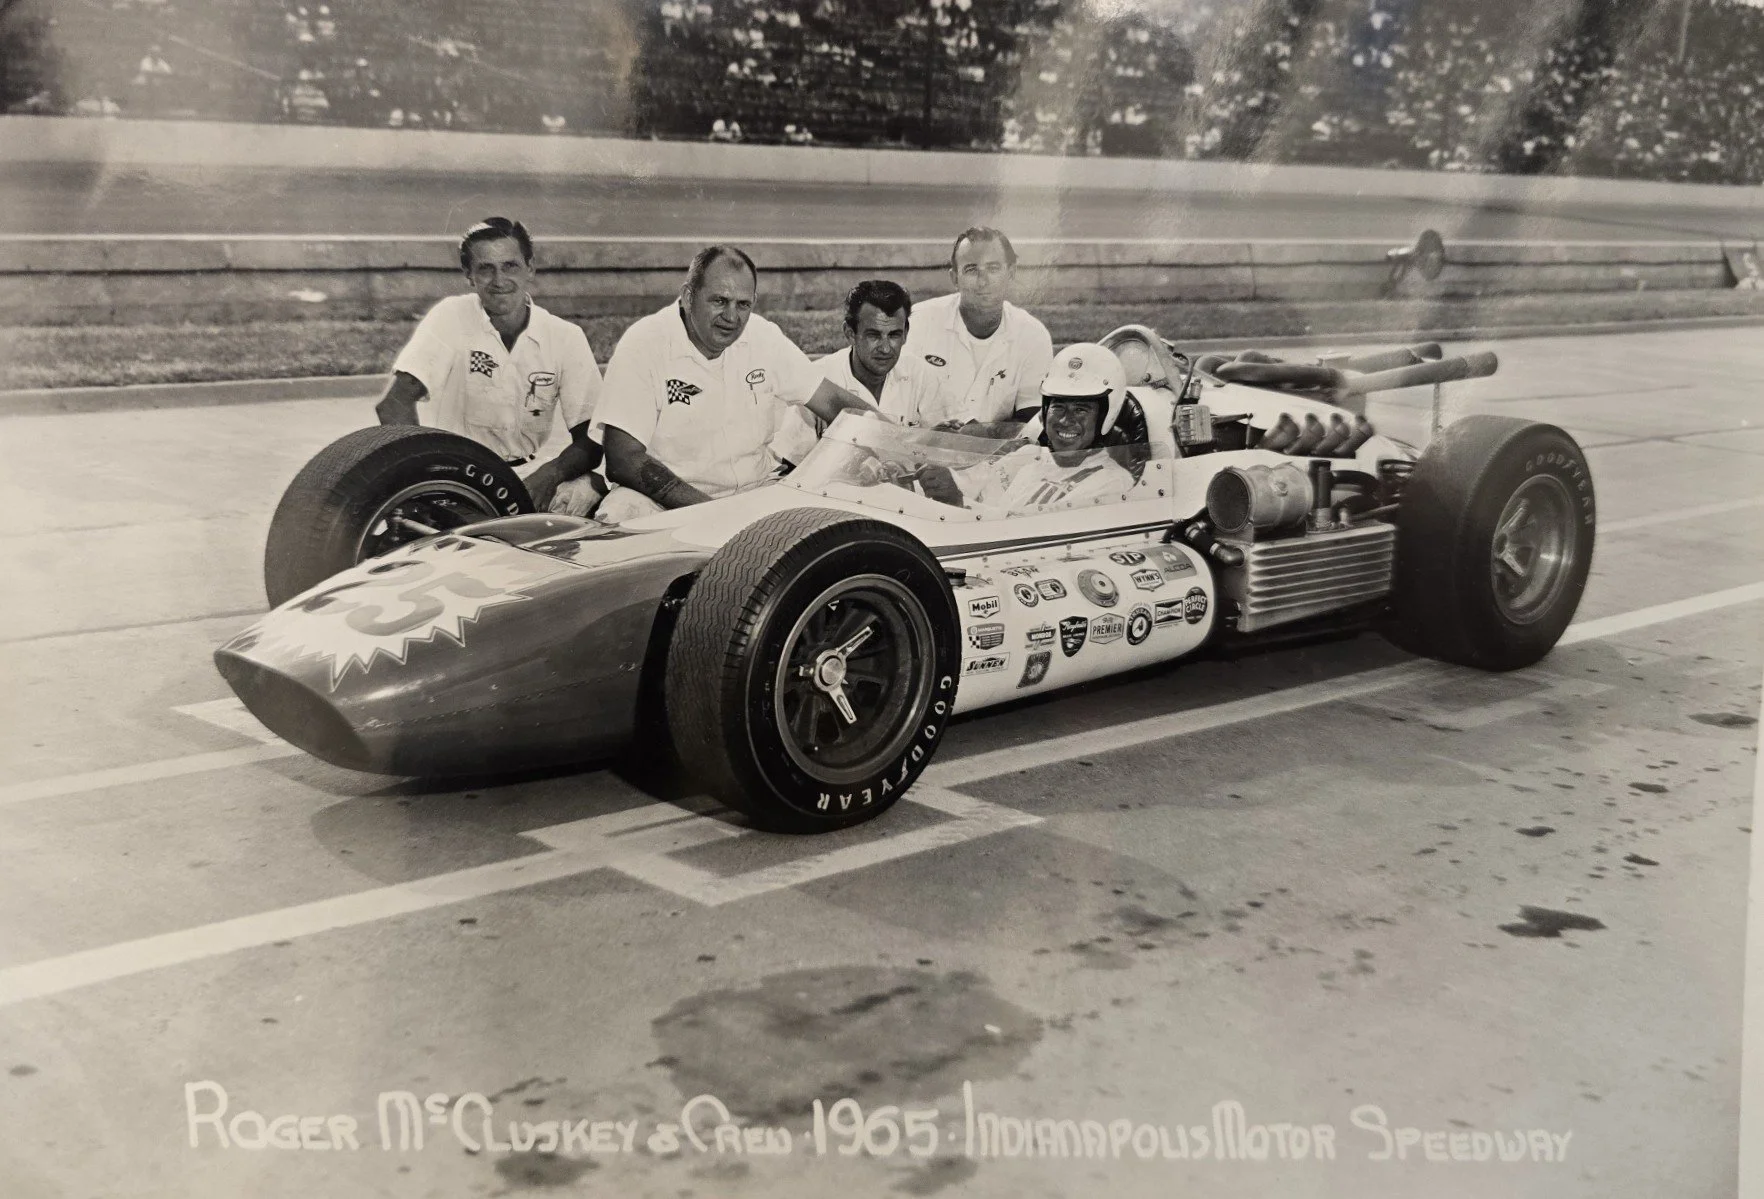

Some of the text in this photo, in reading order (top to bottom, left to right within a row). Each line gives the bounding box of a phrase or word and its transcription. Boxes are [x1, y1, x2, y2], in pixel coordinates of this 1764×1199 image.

[1525, 452, 1594, 525] GOODYEAR
[1112, 552, 1142, 564] STP
[1164, 564, 1193, 573] ALCOA
[1134, 573, 1160, 583] WYNN'S
[972, 600, 998, 612] Mobil
[1185, 595, 1208, 606] PERFECT
[1157, 608, 1181, 616] CHAMPION
[1186, 602, 1206, 613] CIRCLE
[1092, 624, 1122, 635] PREMIER
[1031, 631, 1052, 640] MONROE
[816, 675, 952, 811] GOODYEAR
